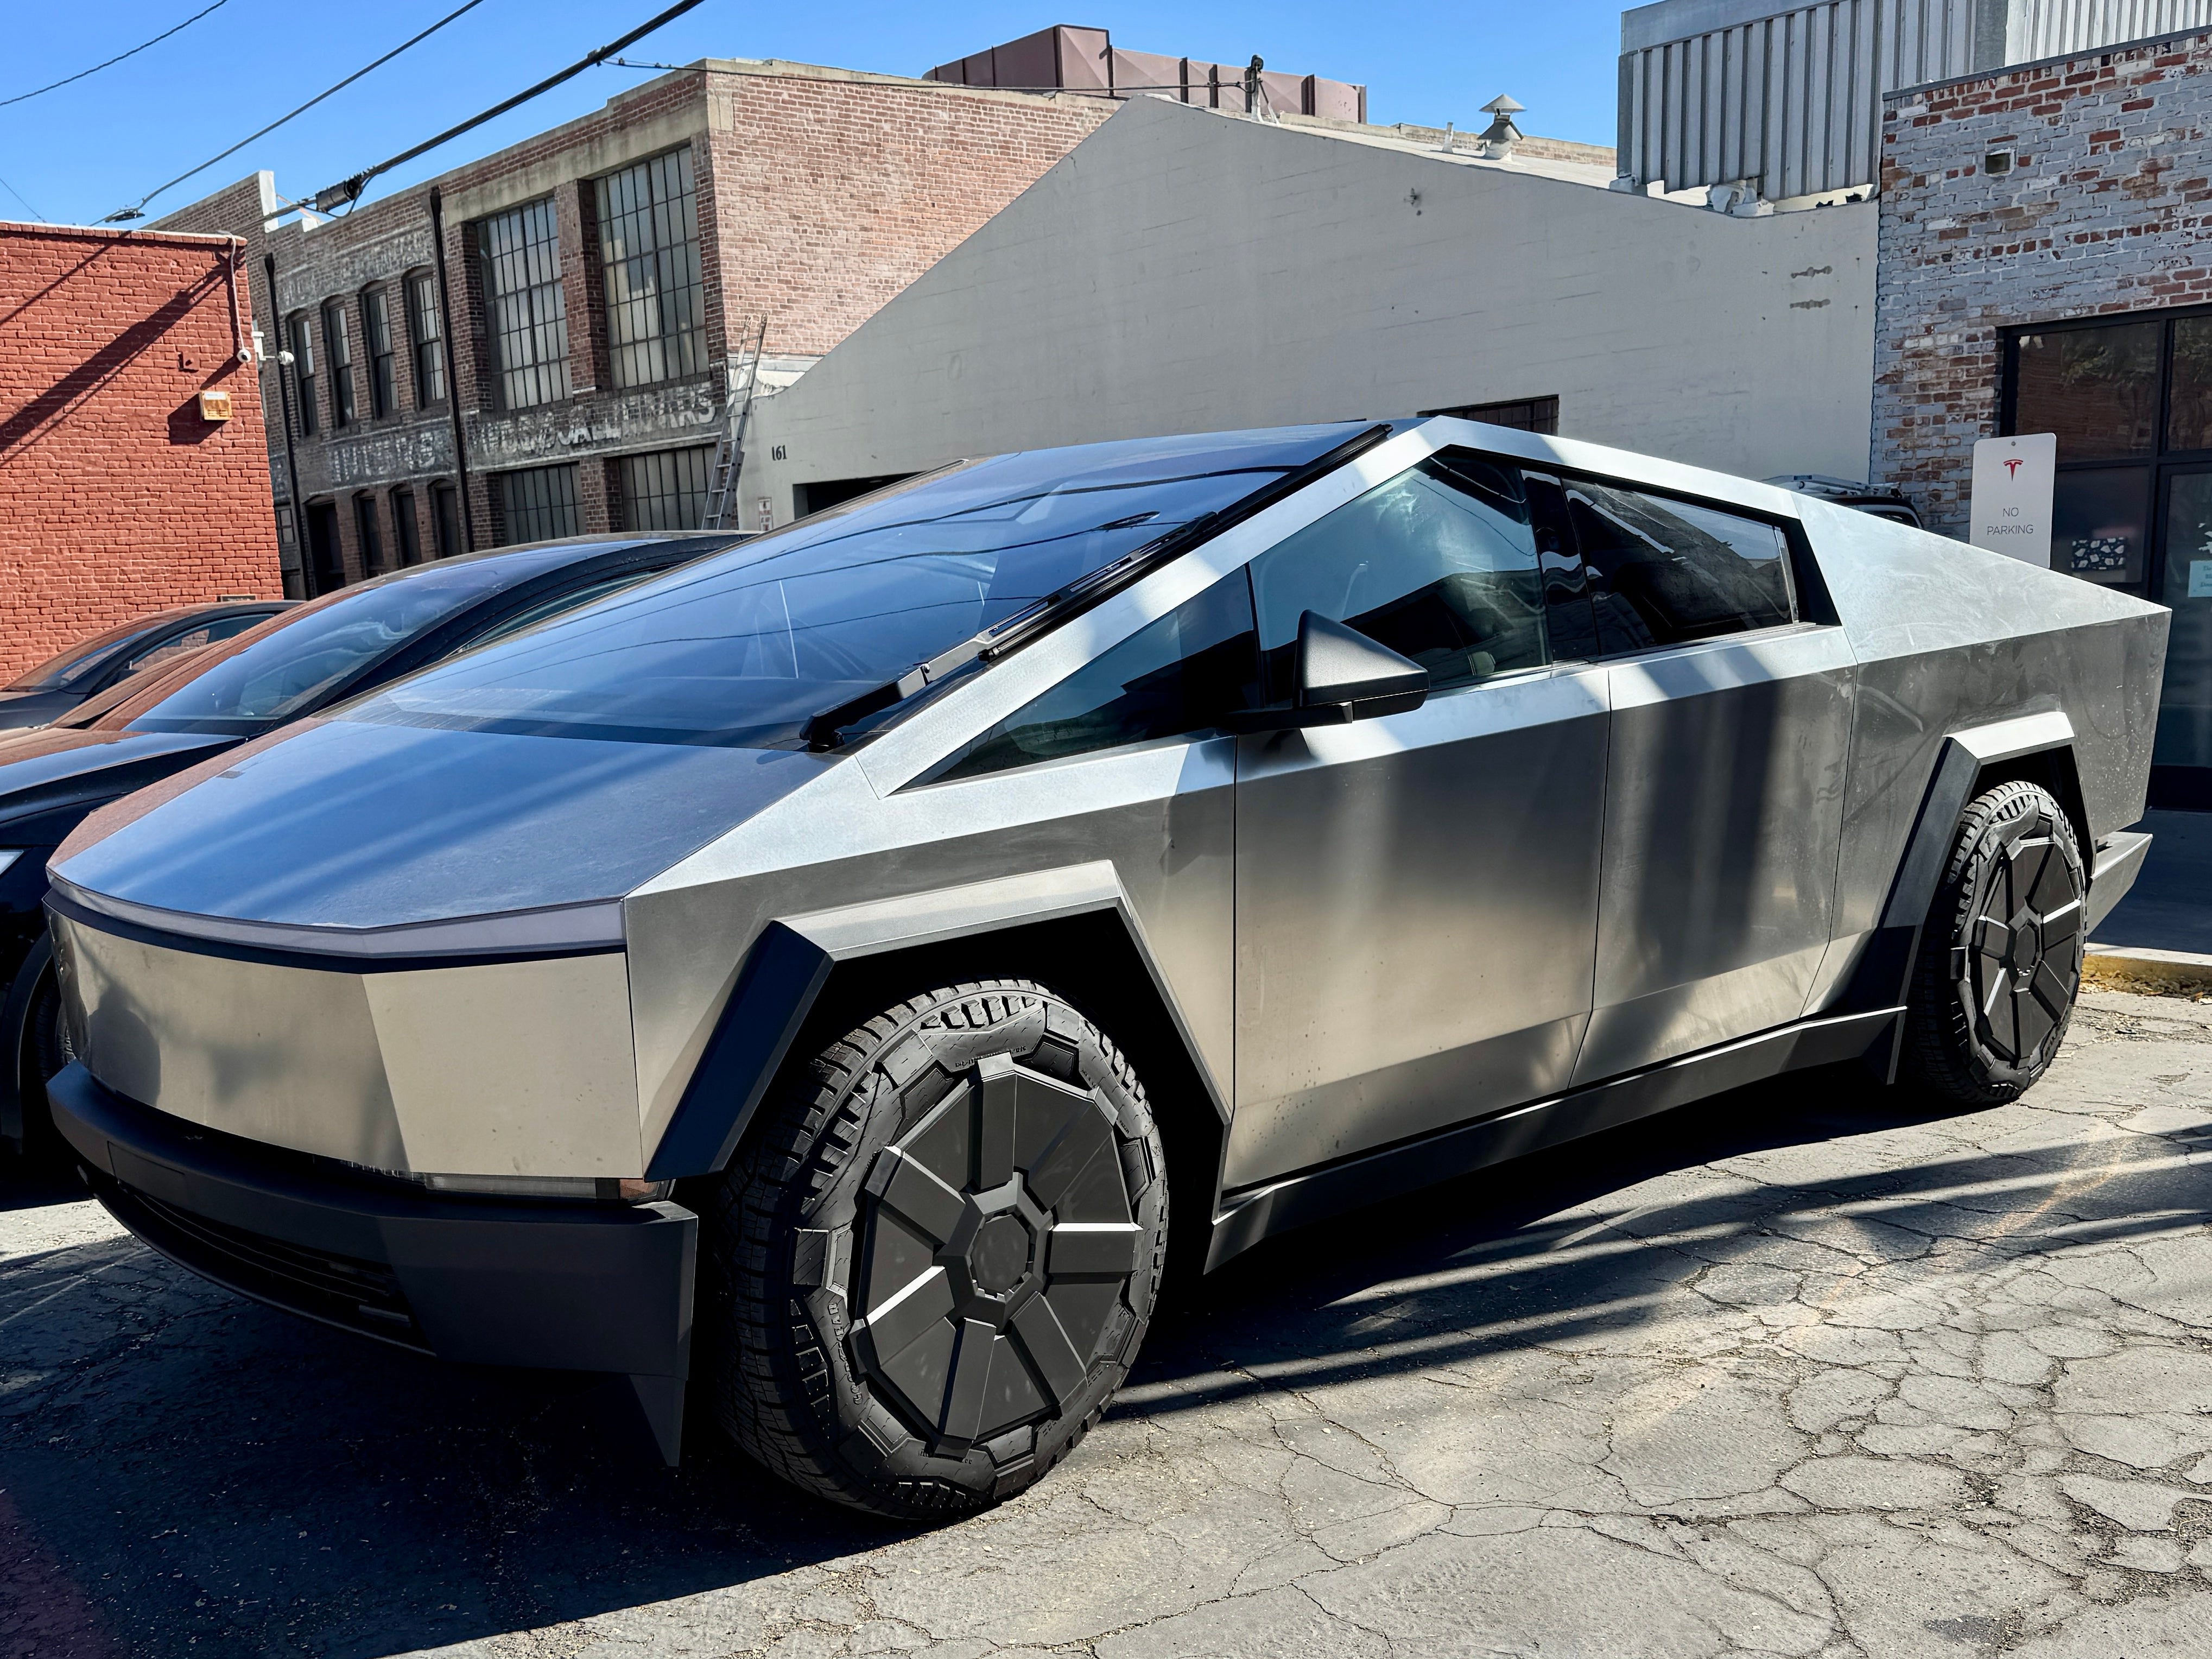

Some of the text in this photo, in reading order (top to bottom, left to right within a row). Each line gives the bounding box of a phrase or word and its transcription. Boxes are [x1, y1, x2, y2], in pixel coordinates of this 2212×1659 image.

[771, 445, 787, 461] 161
[2003, 508, 2019, 517] NO
[1987, 524, 2033, 535] PARKING
